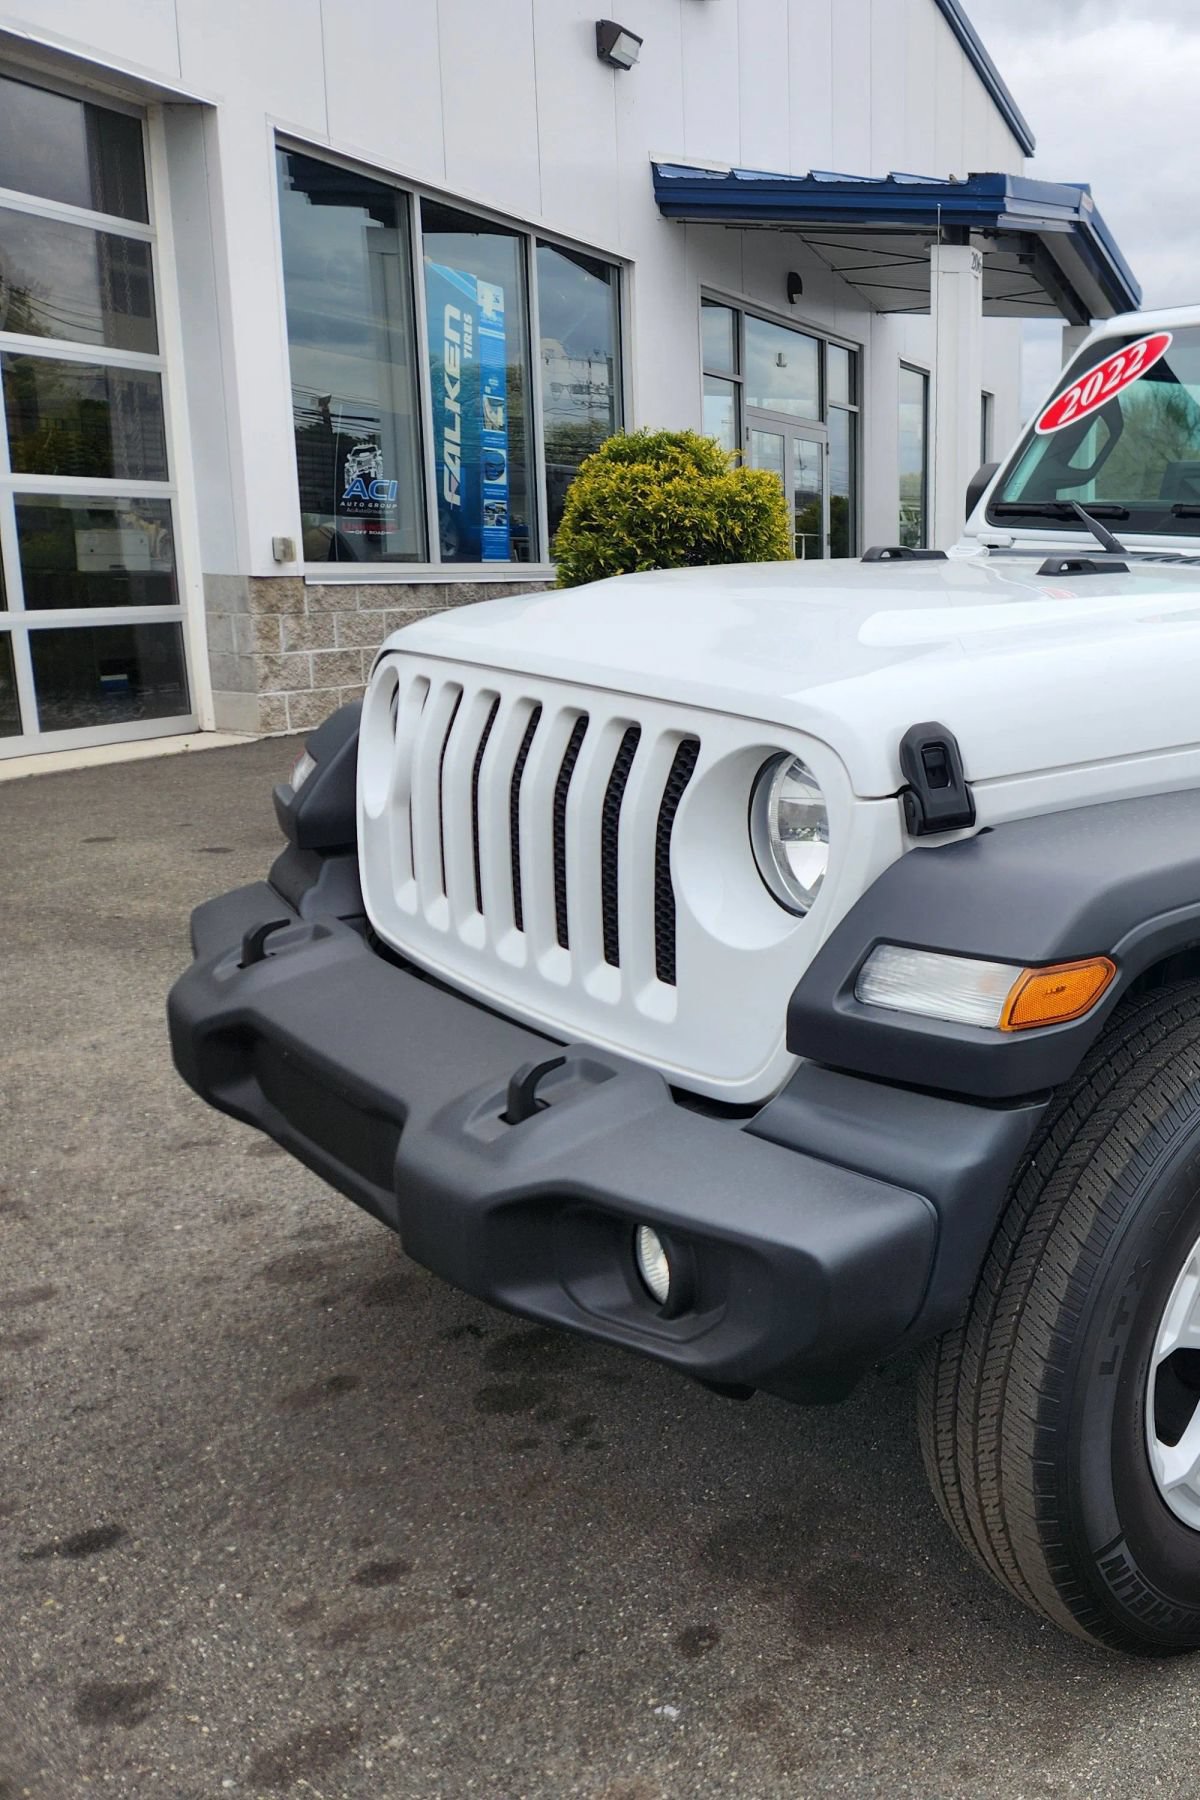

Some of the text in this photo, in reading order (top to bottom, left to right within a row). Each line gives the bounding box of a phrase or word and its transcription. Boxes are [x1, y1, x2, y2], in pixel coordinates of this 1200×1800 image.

[463, 312, 473, 359] TIRES
[443, 303, 461, 507] FALKEN
[1057, 342, 1148, 425] 2022
[342, 478, 398, 501] ACI
[1098, 1254, 1151, 1377] LTX
